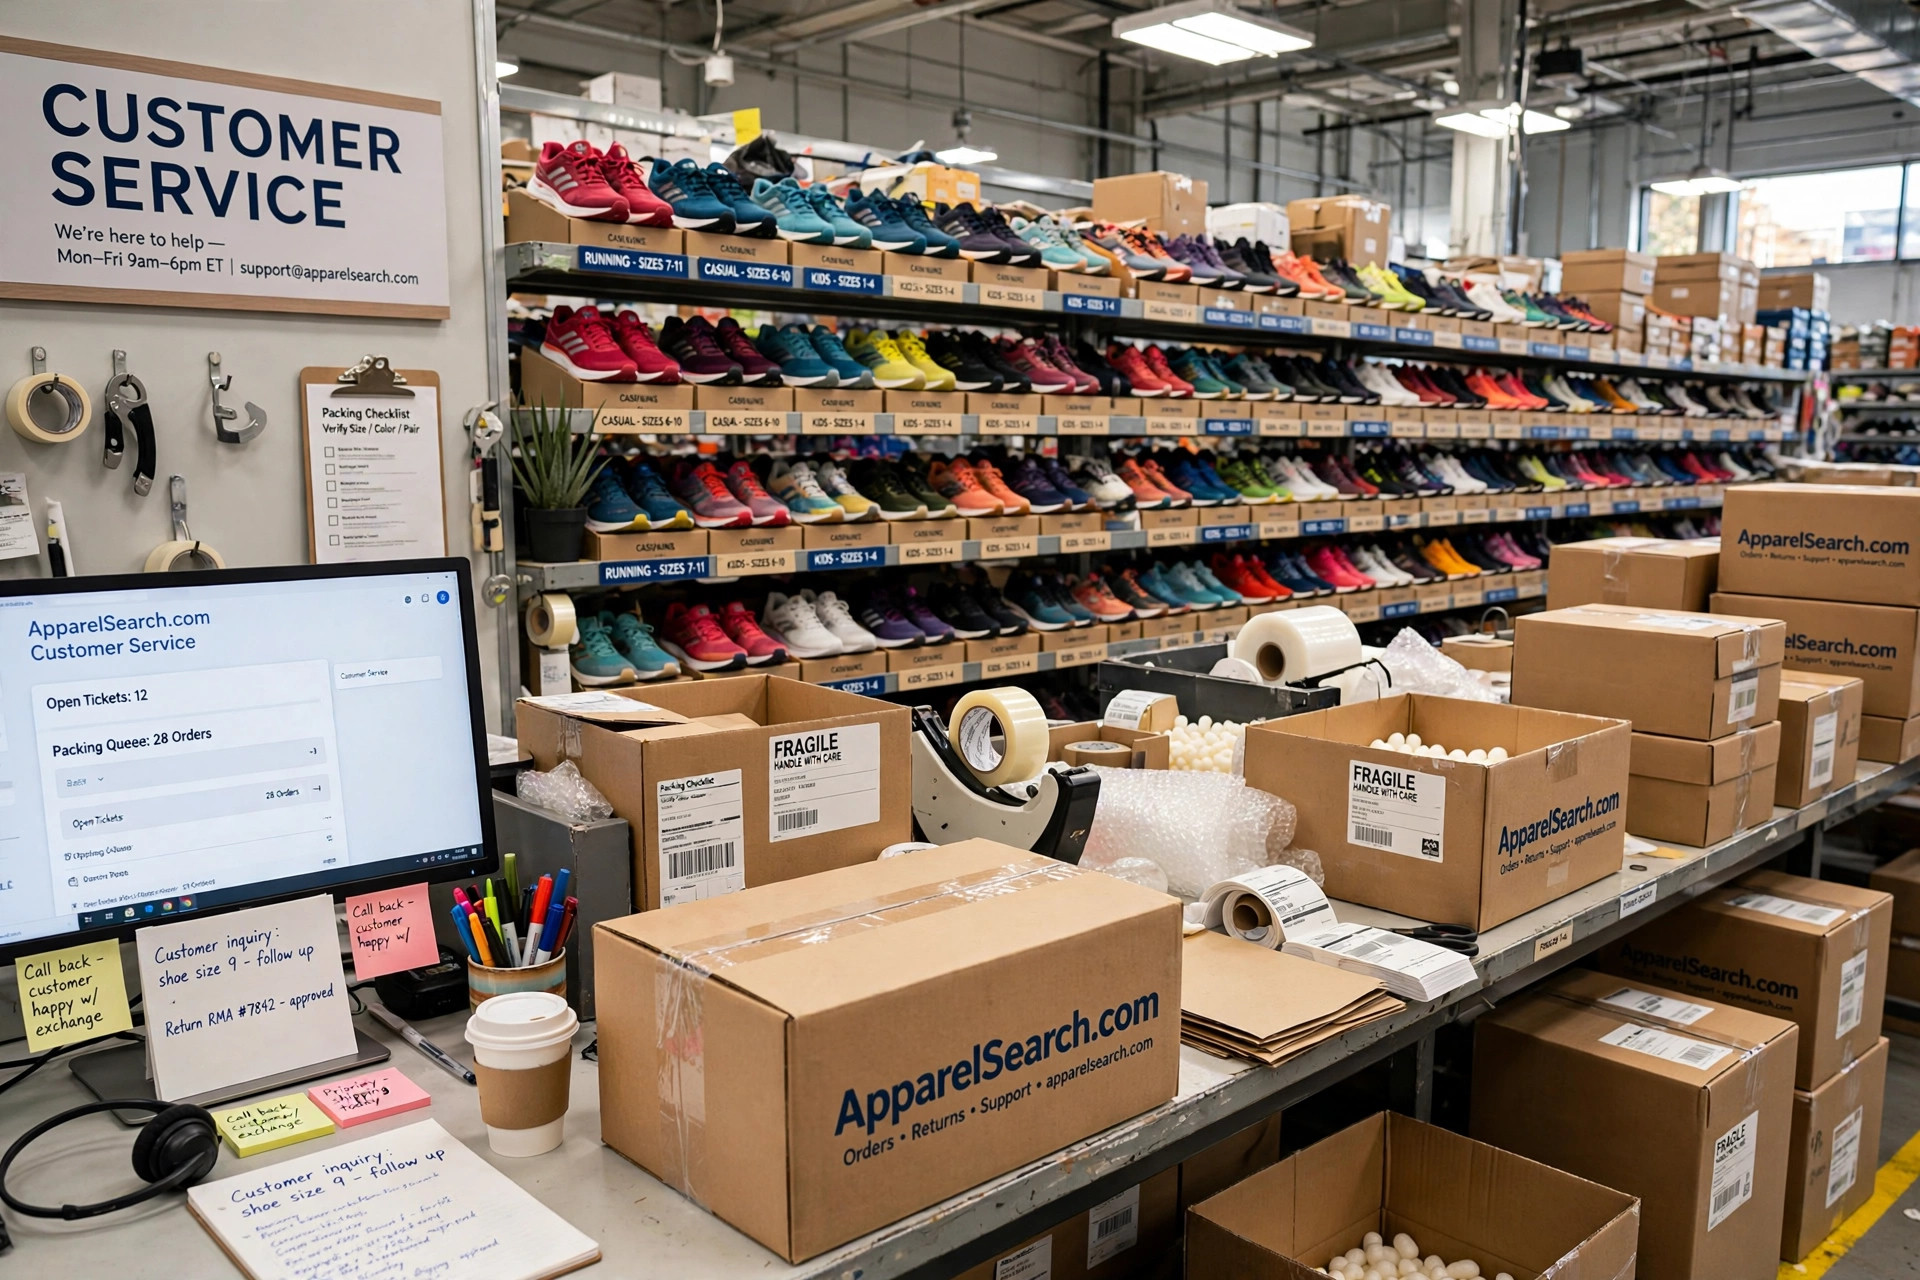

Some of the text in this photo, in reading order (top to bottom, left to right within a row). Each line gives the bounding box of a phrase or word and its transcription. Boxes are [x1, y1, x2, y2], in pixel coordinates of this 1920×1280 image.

[42, 83, 402, 174] CUSTOMER
[51, 151, 345, 229] SERVICE
[110, 228, 145, 245] here
[150, 232, 165, 247] to
[172, 233, 204, 250] help
[207, 258, 223, 272] ET
[240, 263, 419, 285] support@apparelsearch.com
[585, 252, 682, 272] RUNNING SIZES 7-11
[705, 263, 791, 282] CASUAL SIZES 6-10
[811, 272, 874, 289] KIDS SIZES 1-4
[322, 408, 410, 421] Packing Checklist
[602, 416, 682, 426] CASUAL SIZES 6-10
[812, 418, 828, 427] KIDS
[323, 424, 347, 434] Verify
[350, 424, 366, 433] Size
[375, 423, 395, 433] Color
[404, 424, 420, 433] Pair
[1738, 529, 1910, 555] ApparelSearch.com
[814, 551, 877, 565] KIDS SIZES 1-4
[605, 562, 705, 579] RUNNING SIZES 7-11
[29, 612, 210, 640] ApparelSearch.com
[31, 635, 196, 661] Customer Service
[1785, 633, 1896, 658] elSearch.com
[866, 680, 878, 691] 1-4
[47, 689, 148, 712] Open Tickets: 12
[53, 741, 103, 757] Packing
[153, 733, 168, 746] 28
[172, 728, 212, 743] Orders
[774, 733, 839, 759] FRAGILE
[774, 752, 842, 771] HANDLE WITH CARE
[1354, 765, 1415, 790] FRAGILE
[1498, 792, 1619, 857] ApparelSearch.com
[353, 903, 373, 918] Call
[379, 899, 404, 913] back
[356, 917, 402, 933] customer
[155, 942, 218, 964] Customer
[358, 936, 390, 951] happy
[25, 962, 51, 980] Call
[59, 954, 91, 973] back
[160, 970, 189, 987] shoe
[196, 965, 221, 979] size
[228, 957, 236, 971] 9
[257, 949, 292, 966] follow
[299, 946, 314, 961] up
[1620, 943, 1799, 999] ApparelSearch.com
[29, 976, 92, 997] customer
[32, 987, 98, 1018] happy w/
[166, 1019, 203, 1037] Return
[208, 1009, 233, 1026] RMA
[238, 998, 276, 1017] #7842
[290, 983, 334, 1011] approved
[36, 1012, 103, 1036] exchange
[834, 991, 1159, 1136] ApparelSearch.com
[227, 1103, 289, 1123] Call back
[843, 1037, 1154, 1166] Orders Returns Support apparelsearch.com
[238, 1119, 304, 1139] exchange
[231, 1172, 313, 1203] Customer
[241, 1199, 281, 1218] shoe
[290, 1186, 325, 1202] size
[333, 1176, 345, 1186] 9
[370, 1157, 418, 1179] follow
[425, 1149, 445, 1161] up
